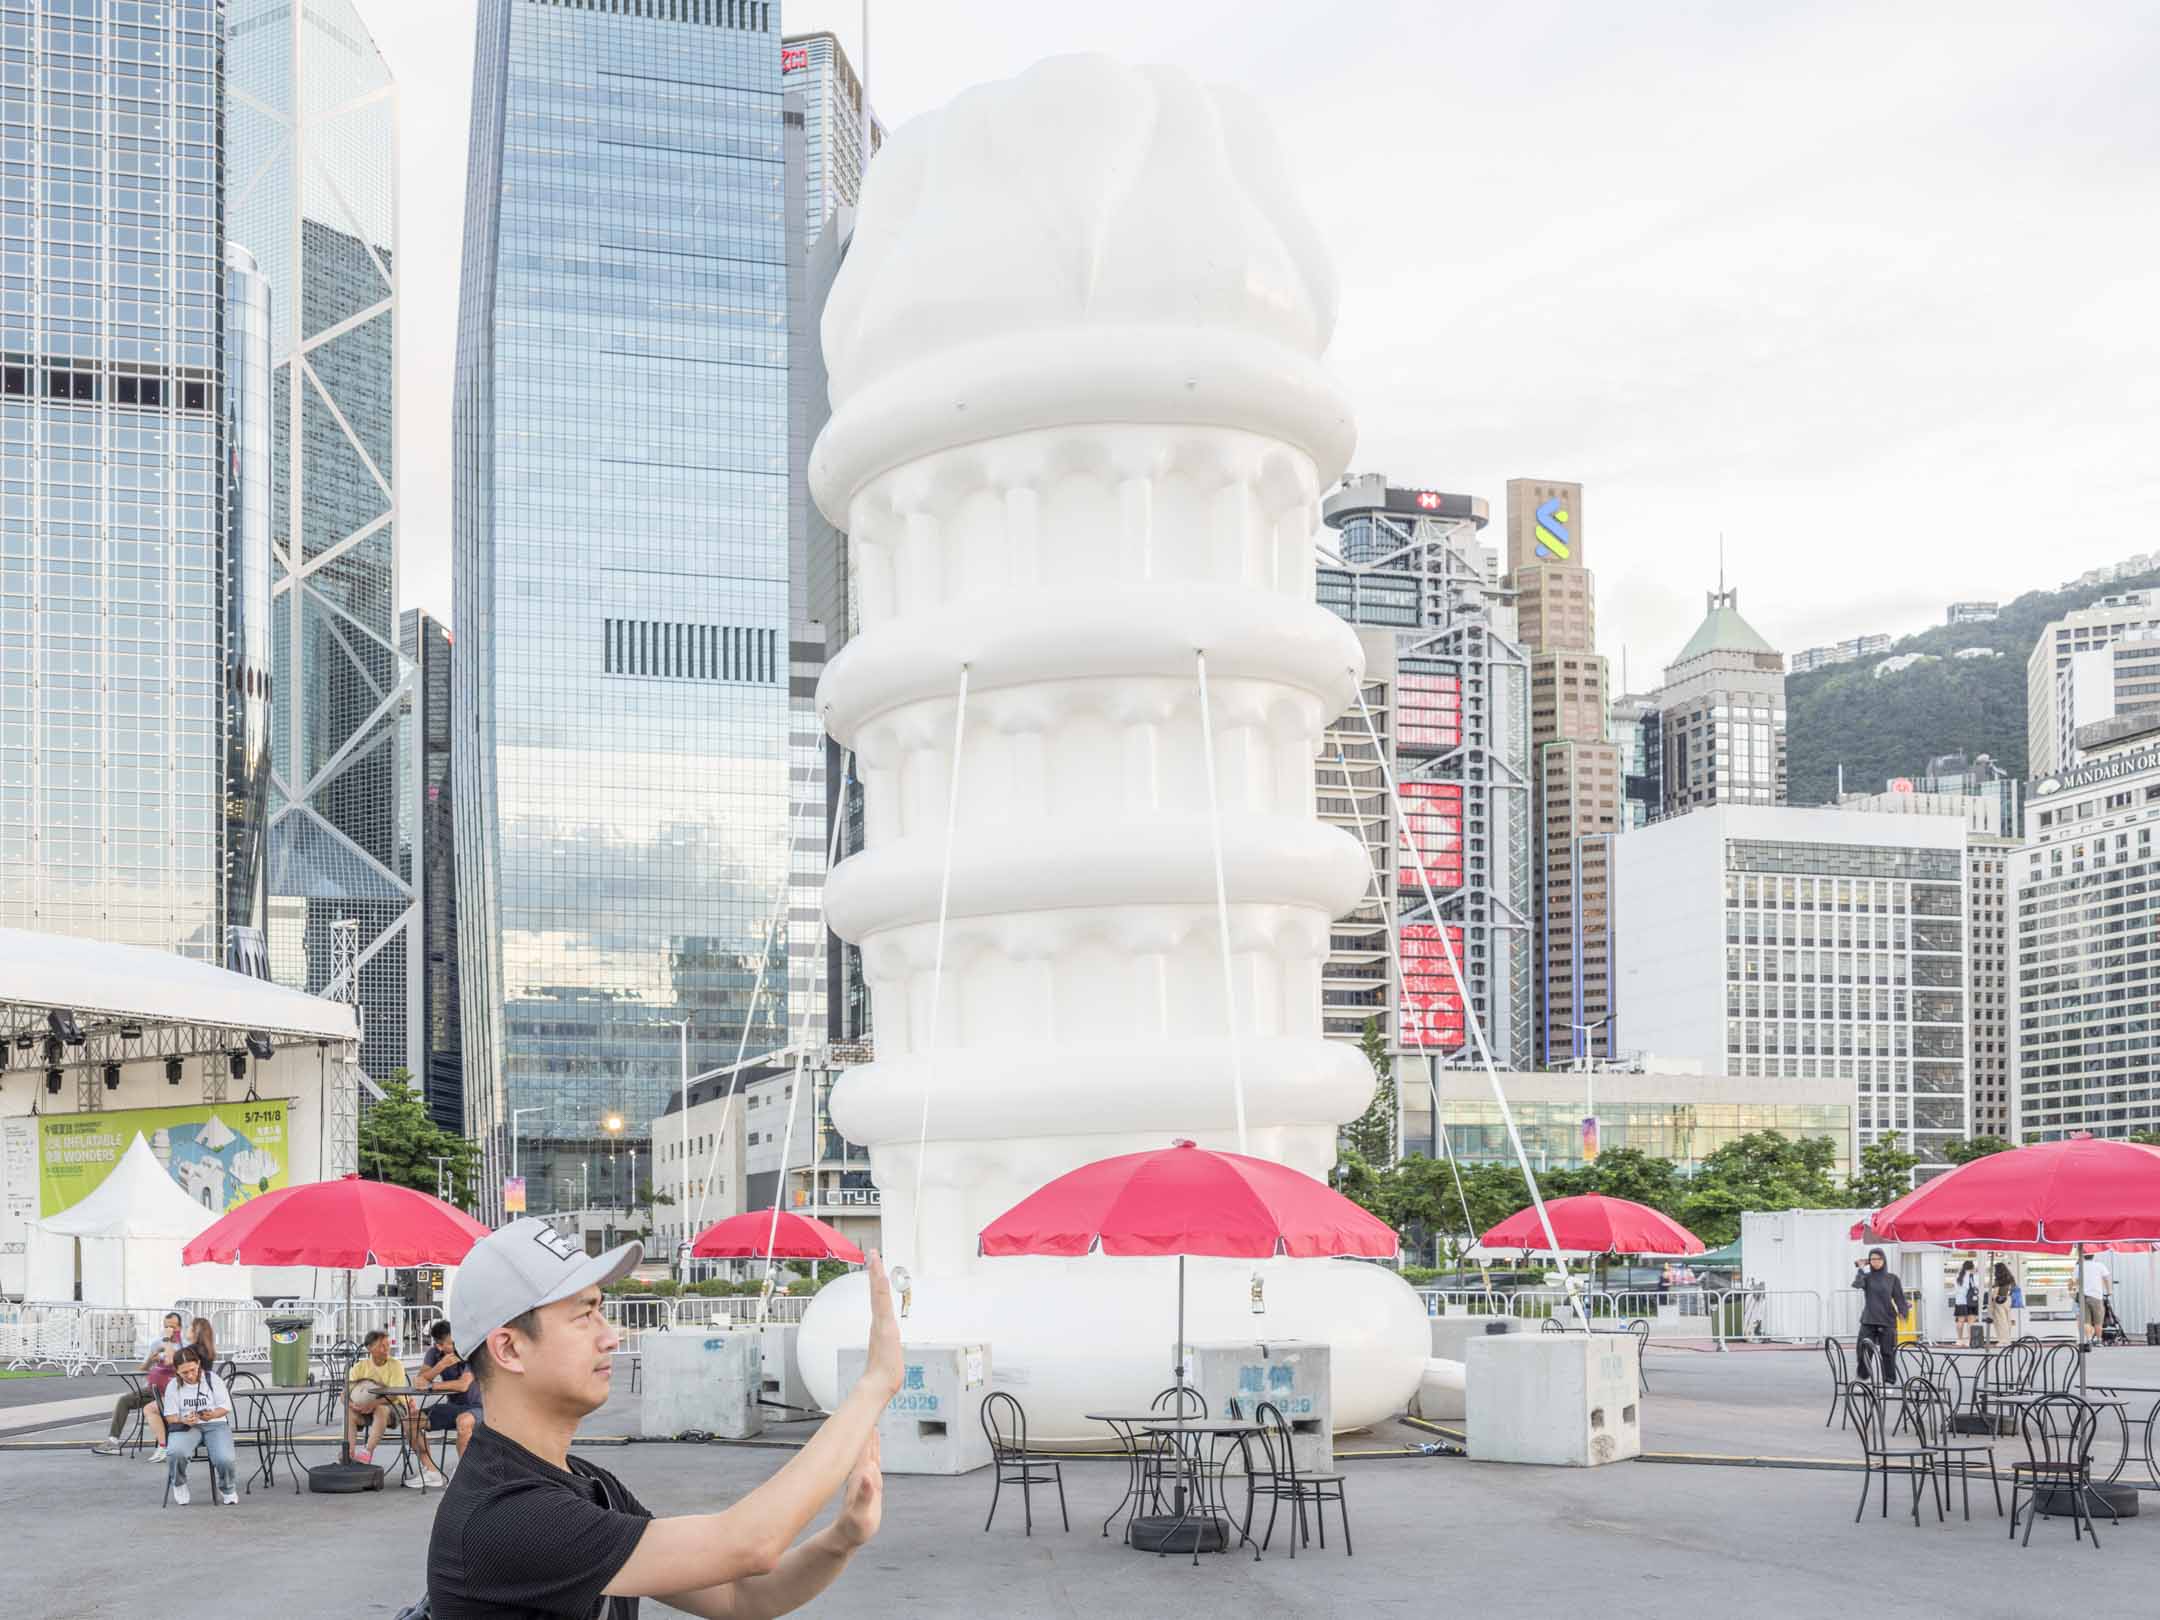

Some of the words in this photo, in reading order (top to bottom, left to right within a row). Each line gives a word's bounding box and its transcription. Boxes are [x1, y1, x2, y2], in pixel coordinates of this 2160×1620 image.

[2063, 759, 2135, 789] MANDARIN
[63, 1150, 115, 1163] WONDERS
[826, 1190, 867, 1205] CITY
[183, 1397, 207, 1408] PUMA
